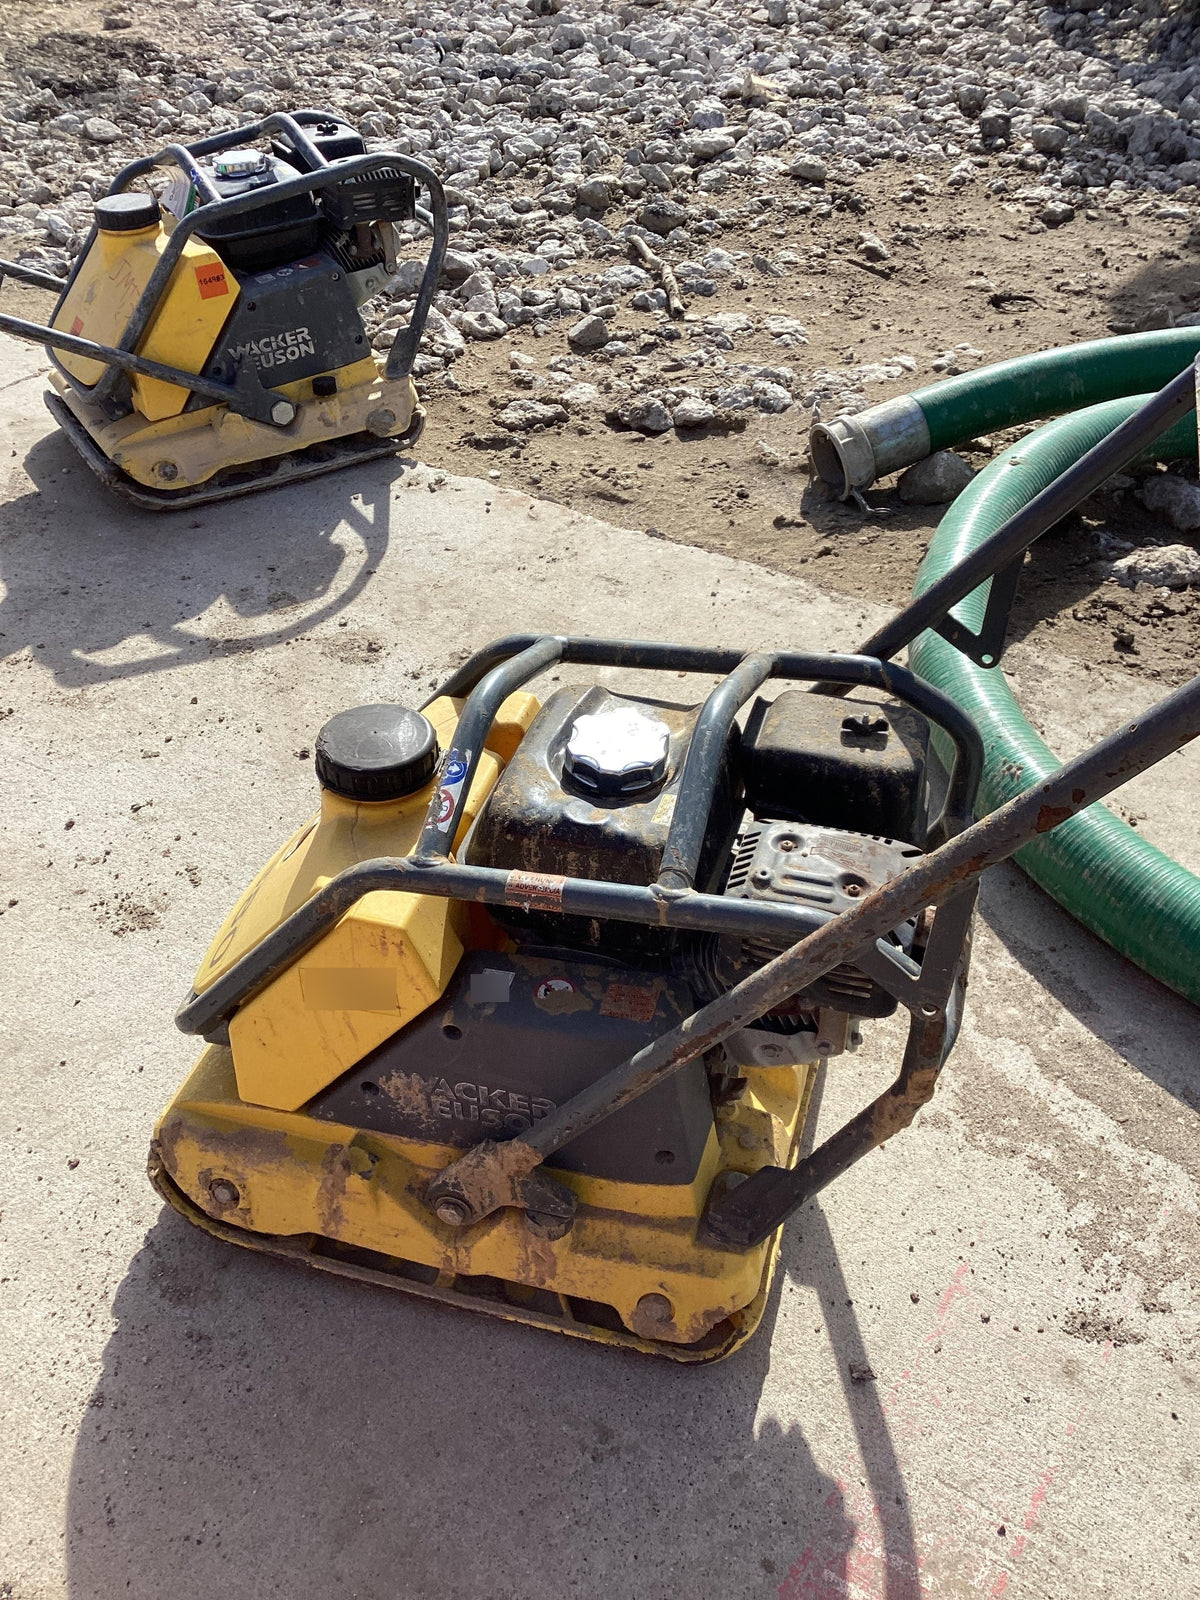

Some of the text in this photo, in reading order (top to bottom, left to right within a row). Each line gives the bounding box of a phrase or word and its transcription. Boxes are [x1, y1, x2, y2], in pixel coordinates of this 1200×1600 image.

[227, 327, 312, 361] WACKER
[252, 341, 315, 370] EUSON
[427, 1076, 558, 1124] ACKER
[430, 1096, 535, 1130] EUSO
